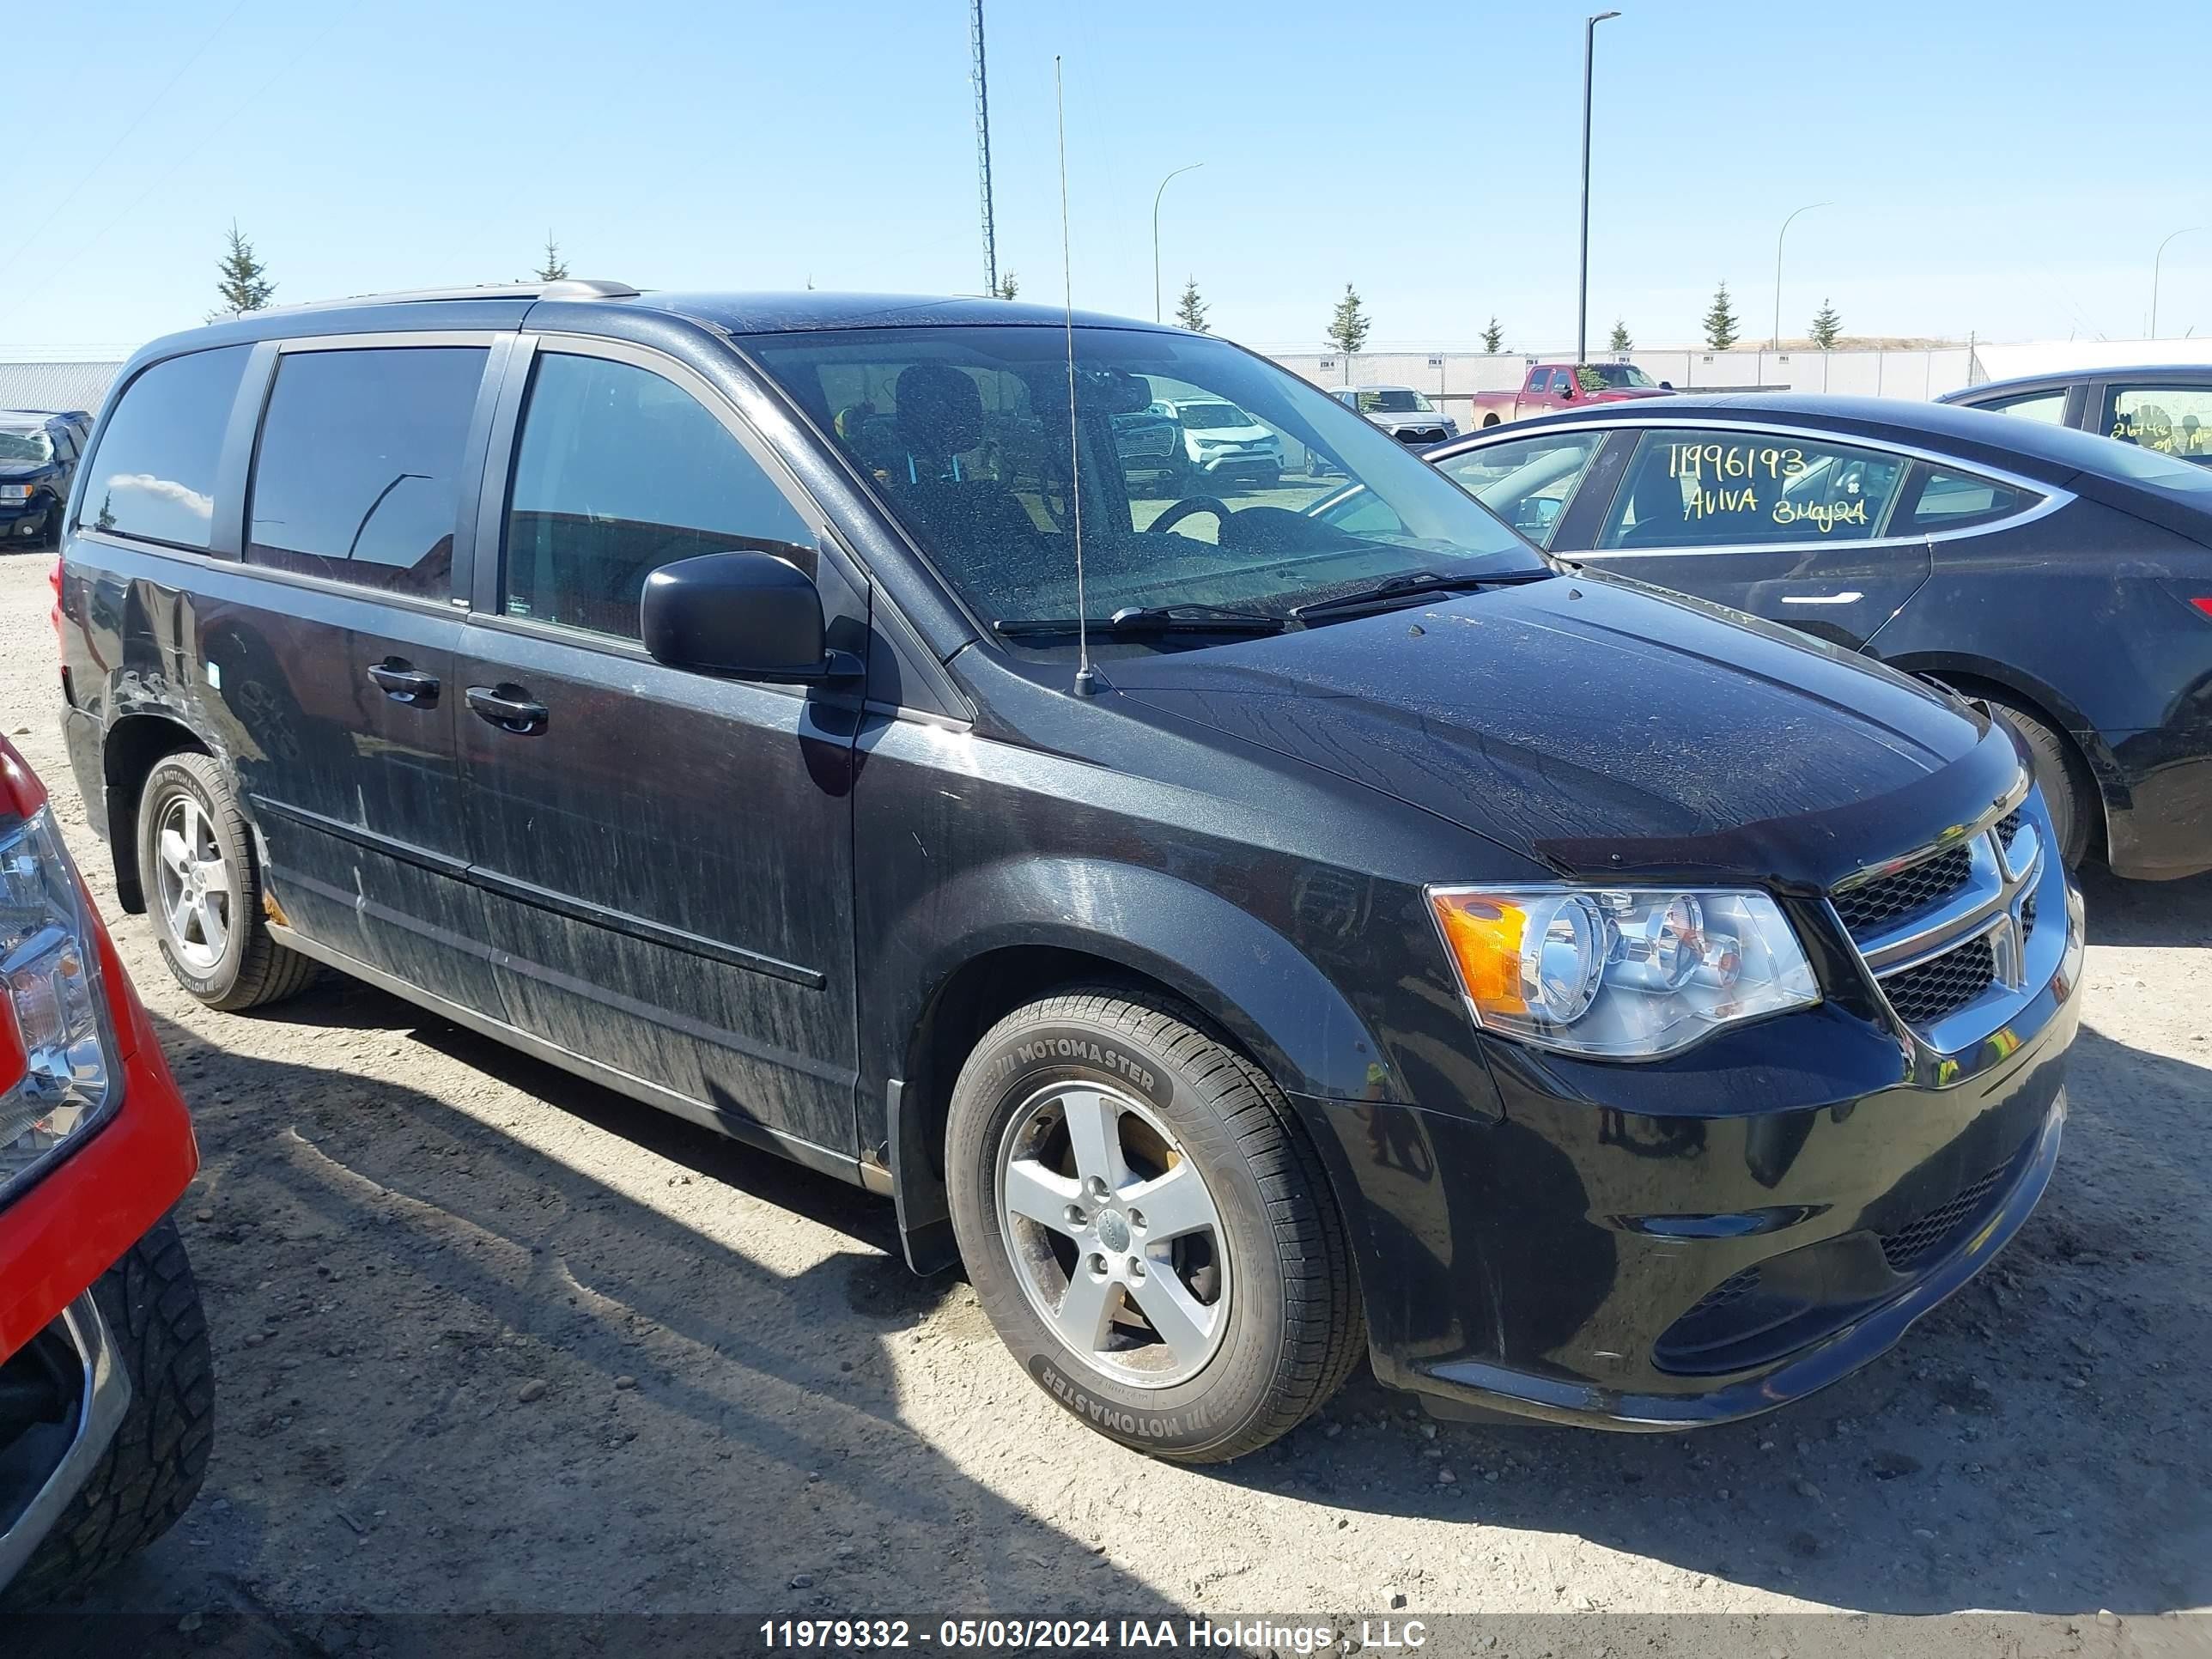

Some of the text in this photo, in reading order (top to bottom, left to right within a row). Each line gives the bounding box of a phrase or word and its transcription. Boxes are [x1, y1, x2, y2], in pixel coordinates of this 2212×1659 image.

[1669, 443, 1807, 481] 11996193
[1684, 486, 1759, 521] AVIVA
[163, 769, 209, 811] MOTOMASTER
[1017, 1038, 1155, 1093] MOTOMASTER
[1042, 1366, 1183, 1437] MOTOMASTER
